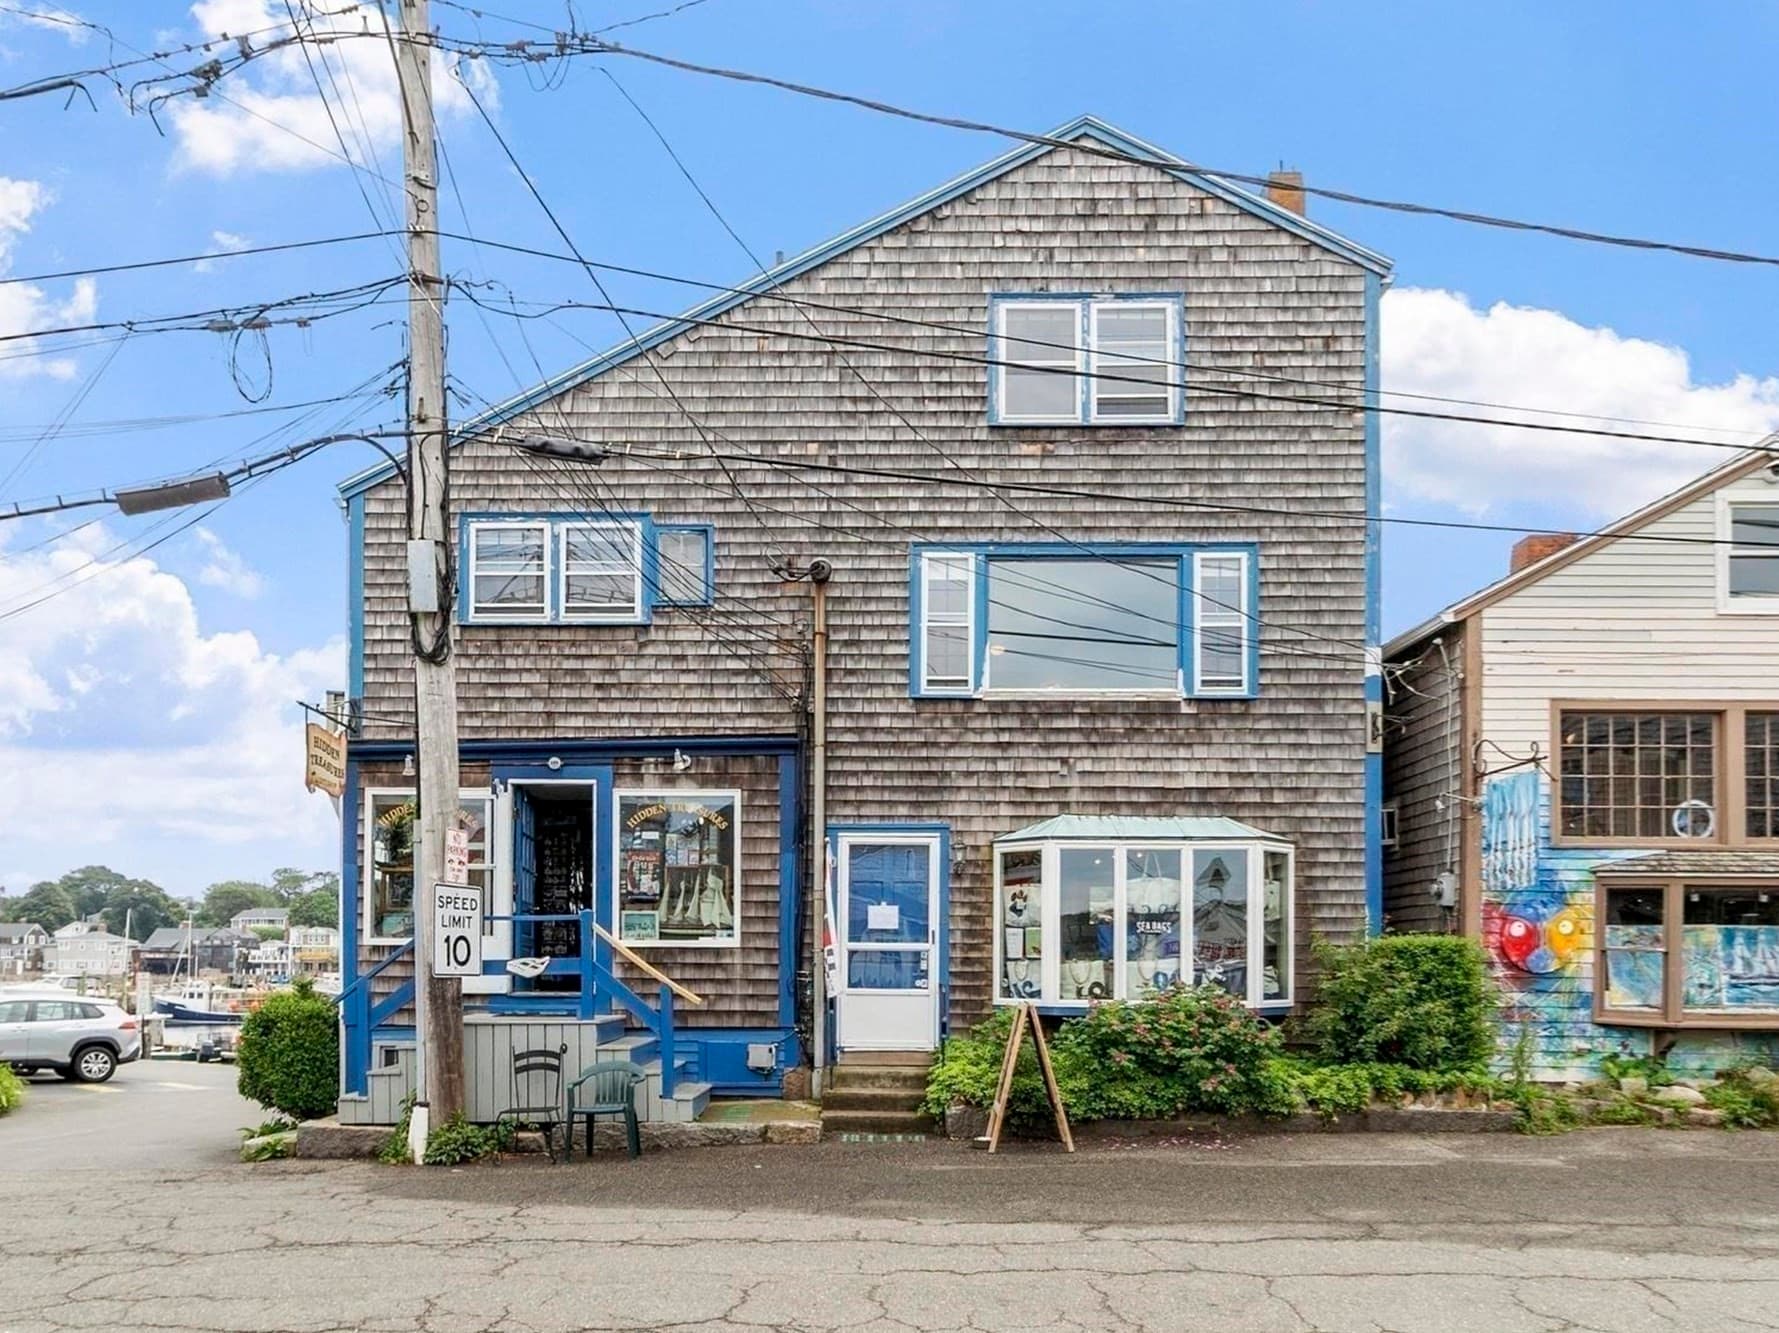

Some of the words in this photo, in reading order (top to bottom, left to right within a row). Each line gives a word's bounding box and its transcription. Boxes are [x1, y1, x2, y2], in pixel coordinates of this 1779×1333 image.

[313, 735, 340, 760] HIDDEN
[626, 804, 667, 829] HIDDEN
[437, 895, 478, 911] SPEED
[441, 914, 473, 928] LIMIT
[444, 934, 471, 967] 10
